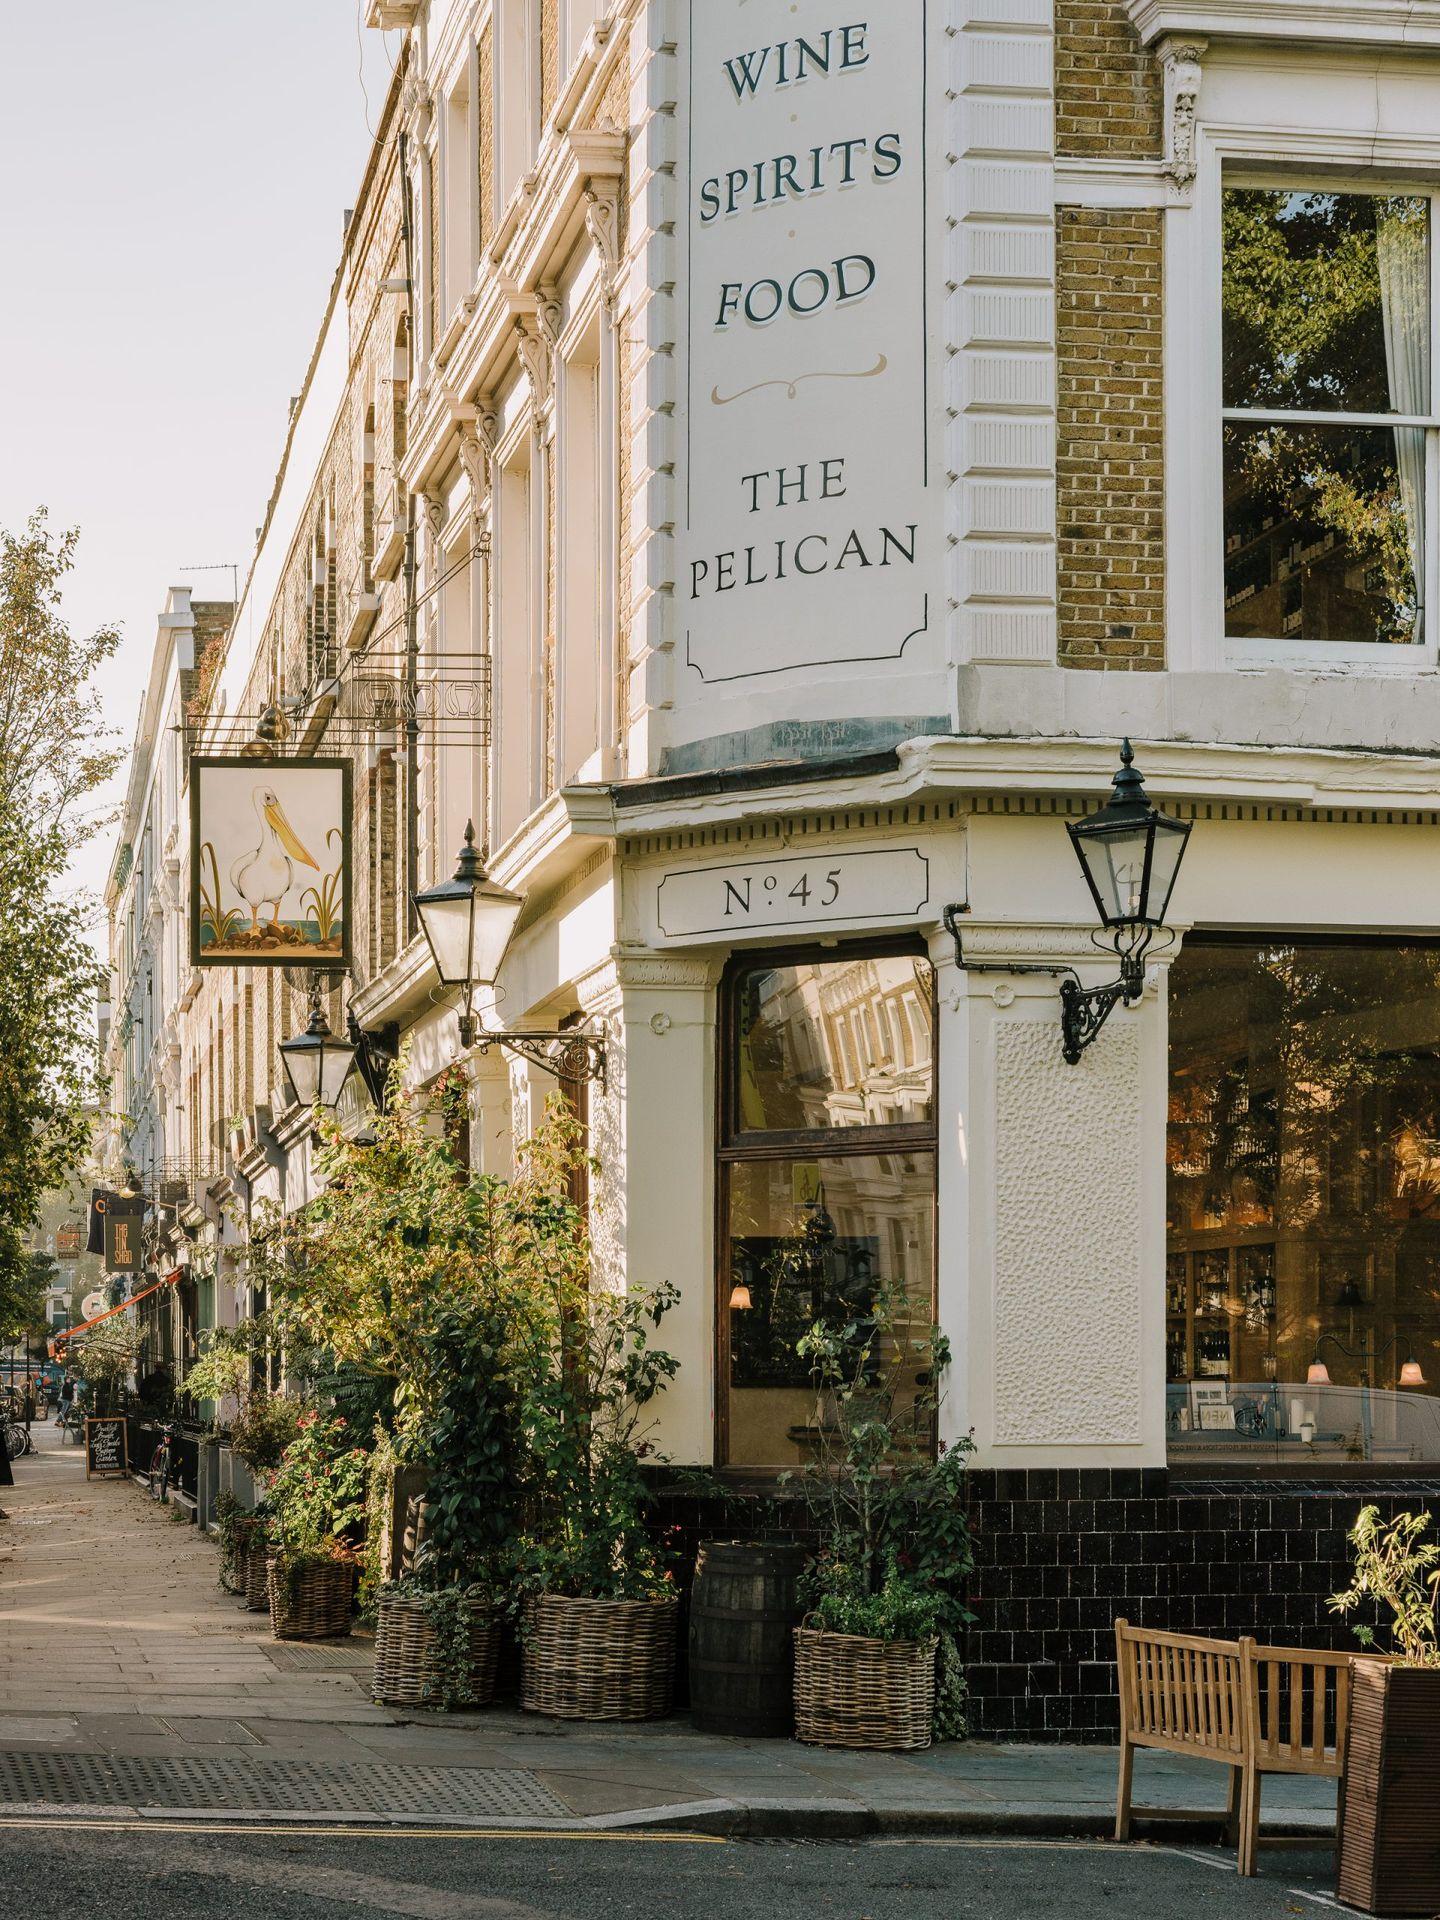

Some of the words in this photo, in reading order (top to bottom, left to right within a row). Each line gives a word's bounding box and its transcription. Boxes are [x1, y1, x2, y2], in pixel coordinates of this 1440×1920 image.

[722, 22, 870, 99] WINE
[699, 133, 902, 222] SPIRITS
[714, 254, 876, 326] FOOD
[741, 458, 847, 513] THE
[690, 524, 919, 600] PELICAN
[114, 1223, 128, 1238] THE
[114, 1237, 127, 1250] TIN
